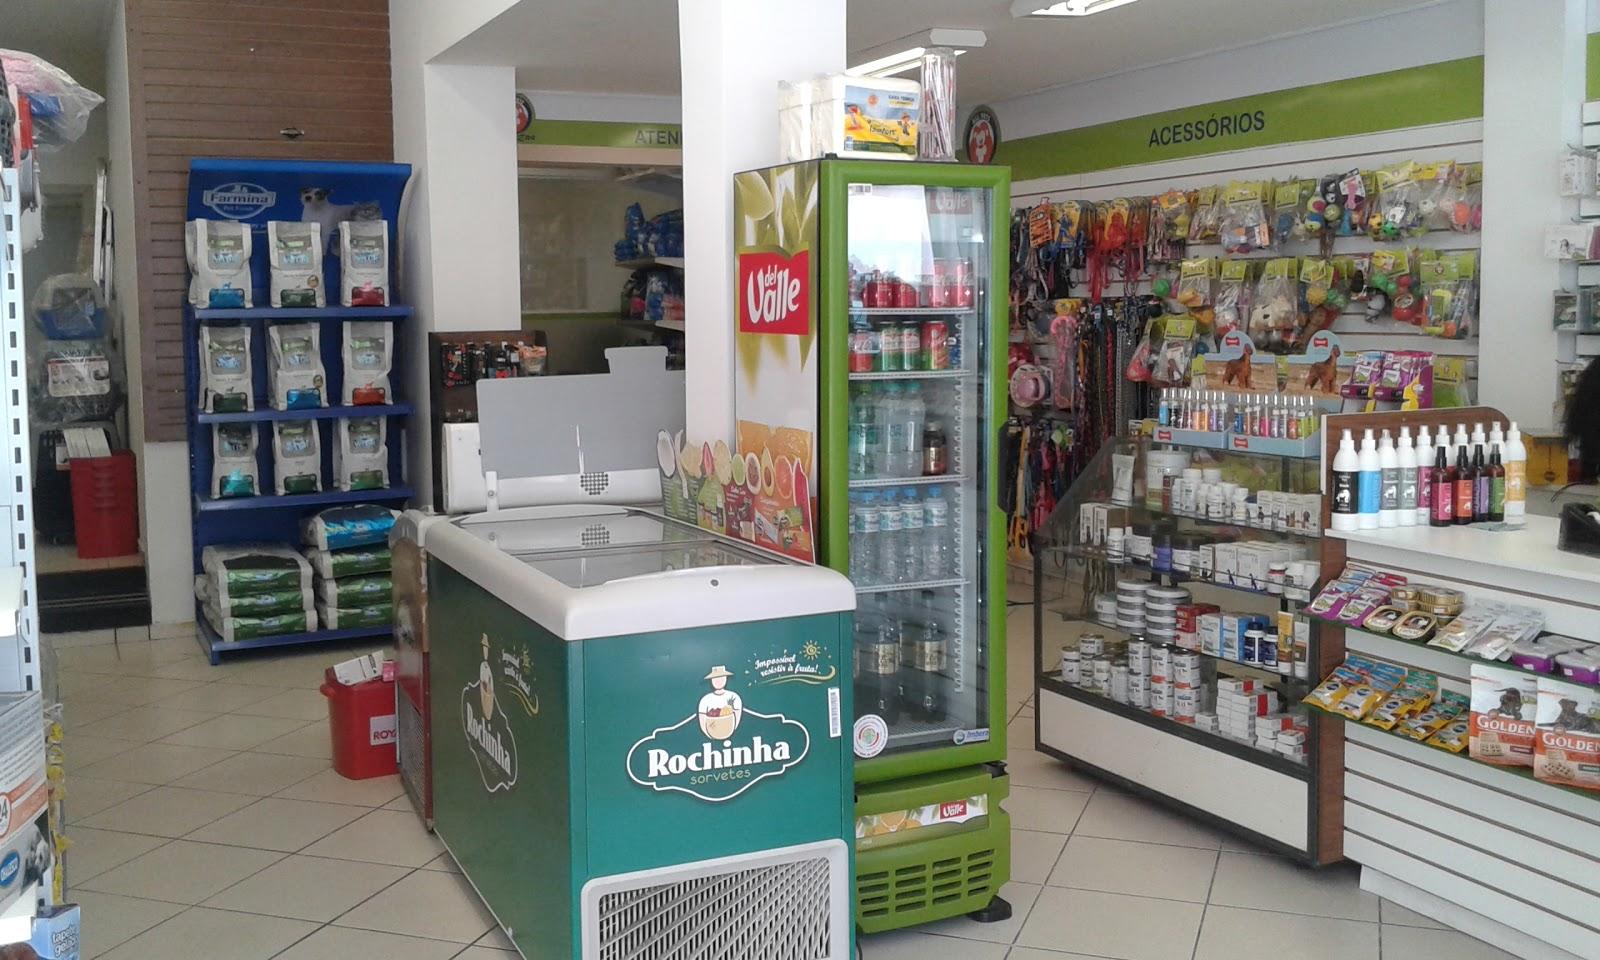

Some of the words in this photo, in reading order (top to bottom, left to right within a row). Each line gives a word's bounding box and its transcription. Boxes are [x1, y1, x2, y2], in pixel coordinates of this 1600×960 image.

[634, 129, 682, 145] ATEN
[1148, 111, 1265, 148] ACESSÓRIOS
[210, 192, 269, 203] Farmina
[764, 264, 778, 288] del
[747, 267, 801, 324] Valle
[1476, 714, 1537, 735] GOLDEN
[466, 702, 512, 777] Rochinha
[647, 735, 790, 778] Rochinha
[689, 768, 752, 786] sorvetes
